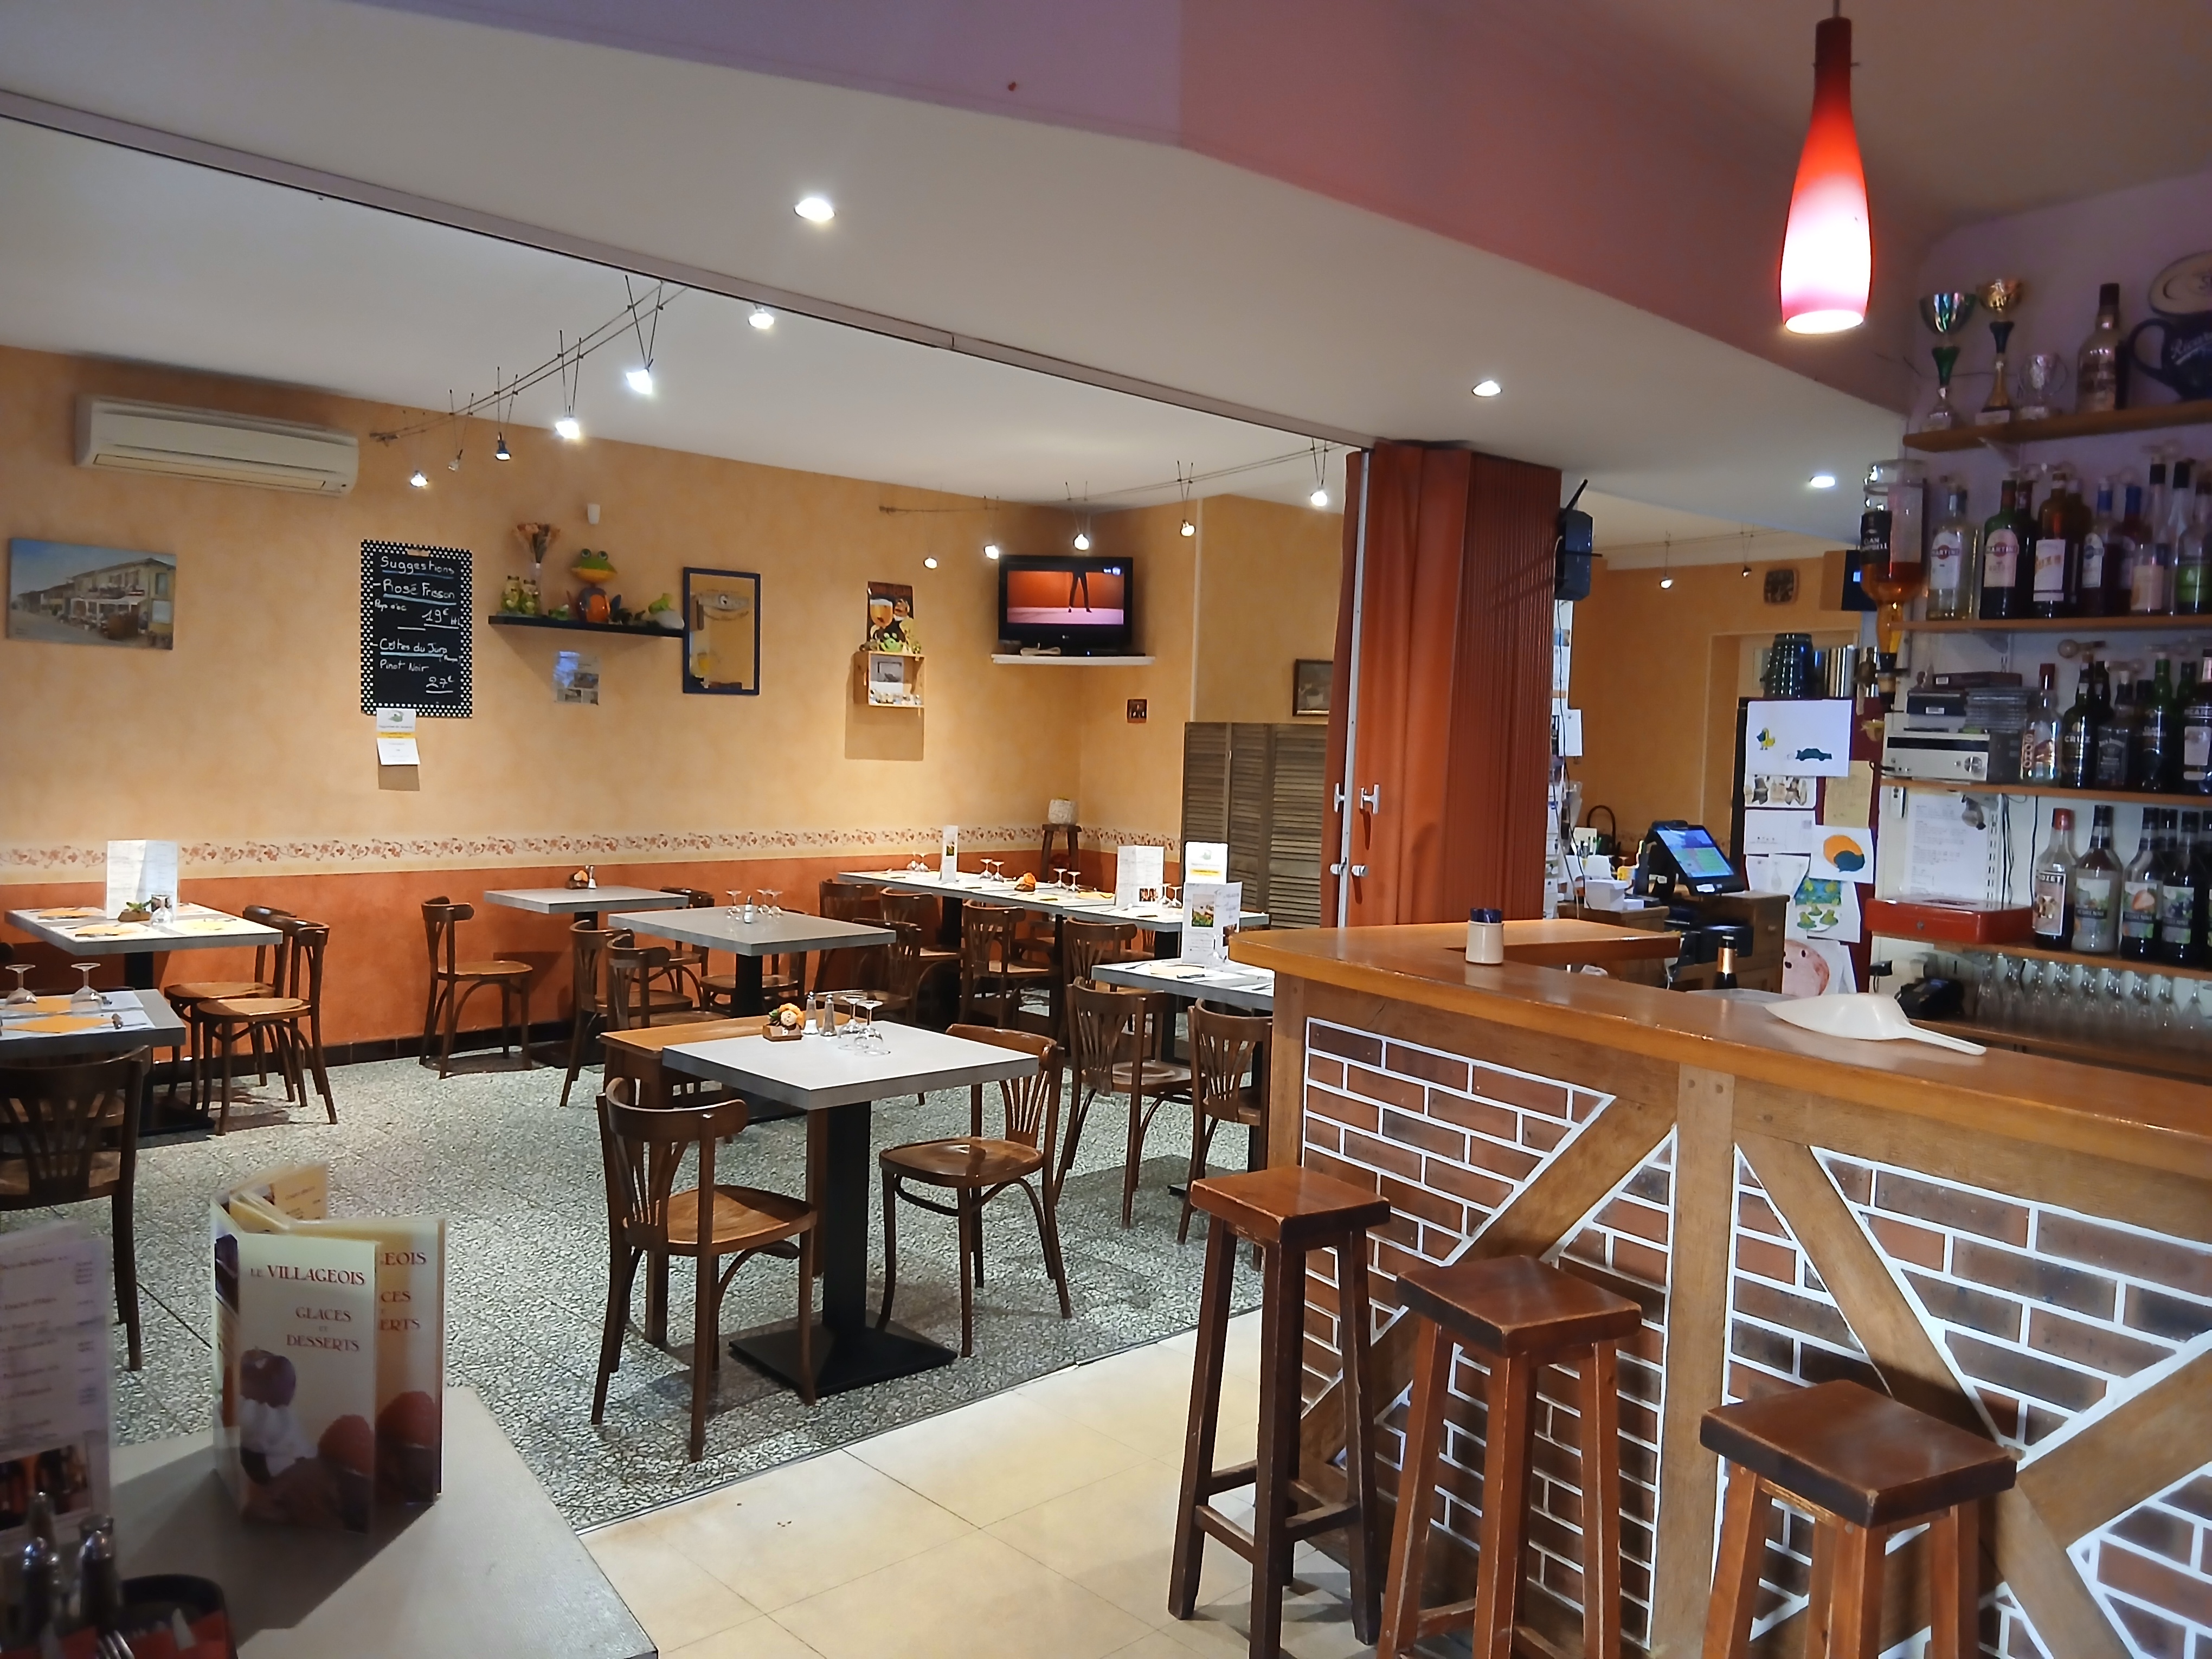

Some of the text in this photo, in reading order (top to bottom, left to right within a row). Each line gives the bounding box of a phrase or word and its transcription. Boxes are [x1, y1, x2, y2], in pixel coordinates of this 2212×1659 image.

[380, 555, 455, 575] Suggestions
[413, 642, 425, 652] du
[380, 659, 406, 670] Pinot
[381, 1251, 427, 1266] EOIS
[267, 1264, 366, 1286] VILLAGEOIS
[295, 1306, 352, 1323] GLACES
[286, 1334, 361, 1352] DESSERTS
